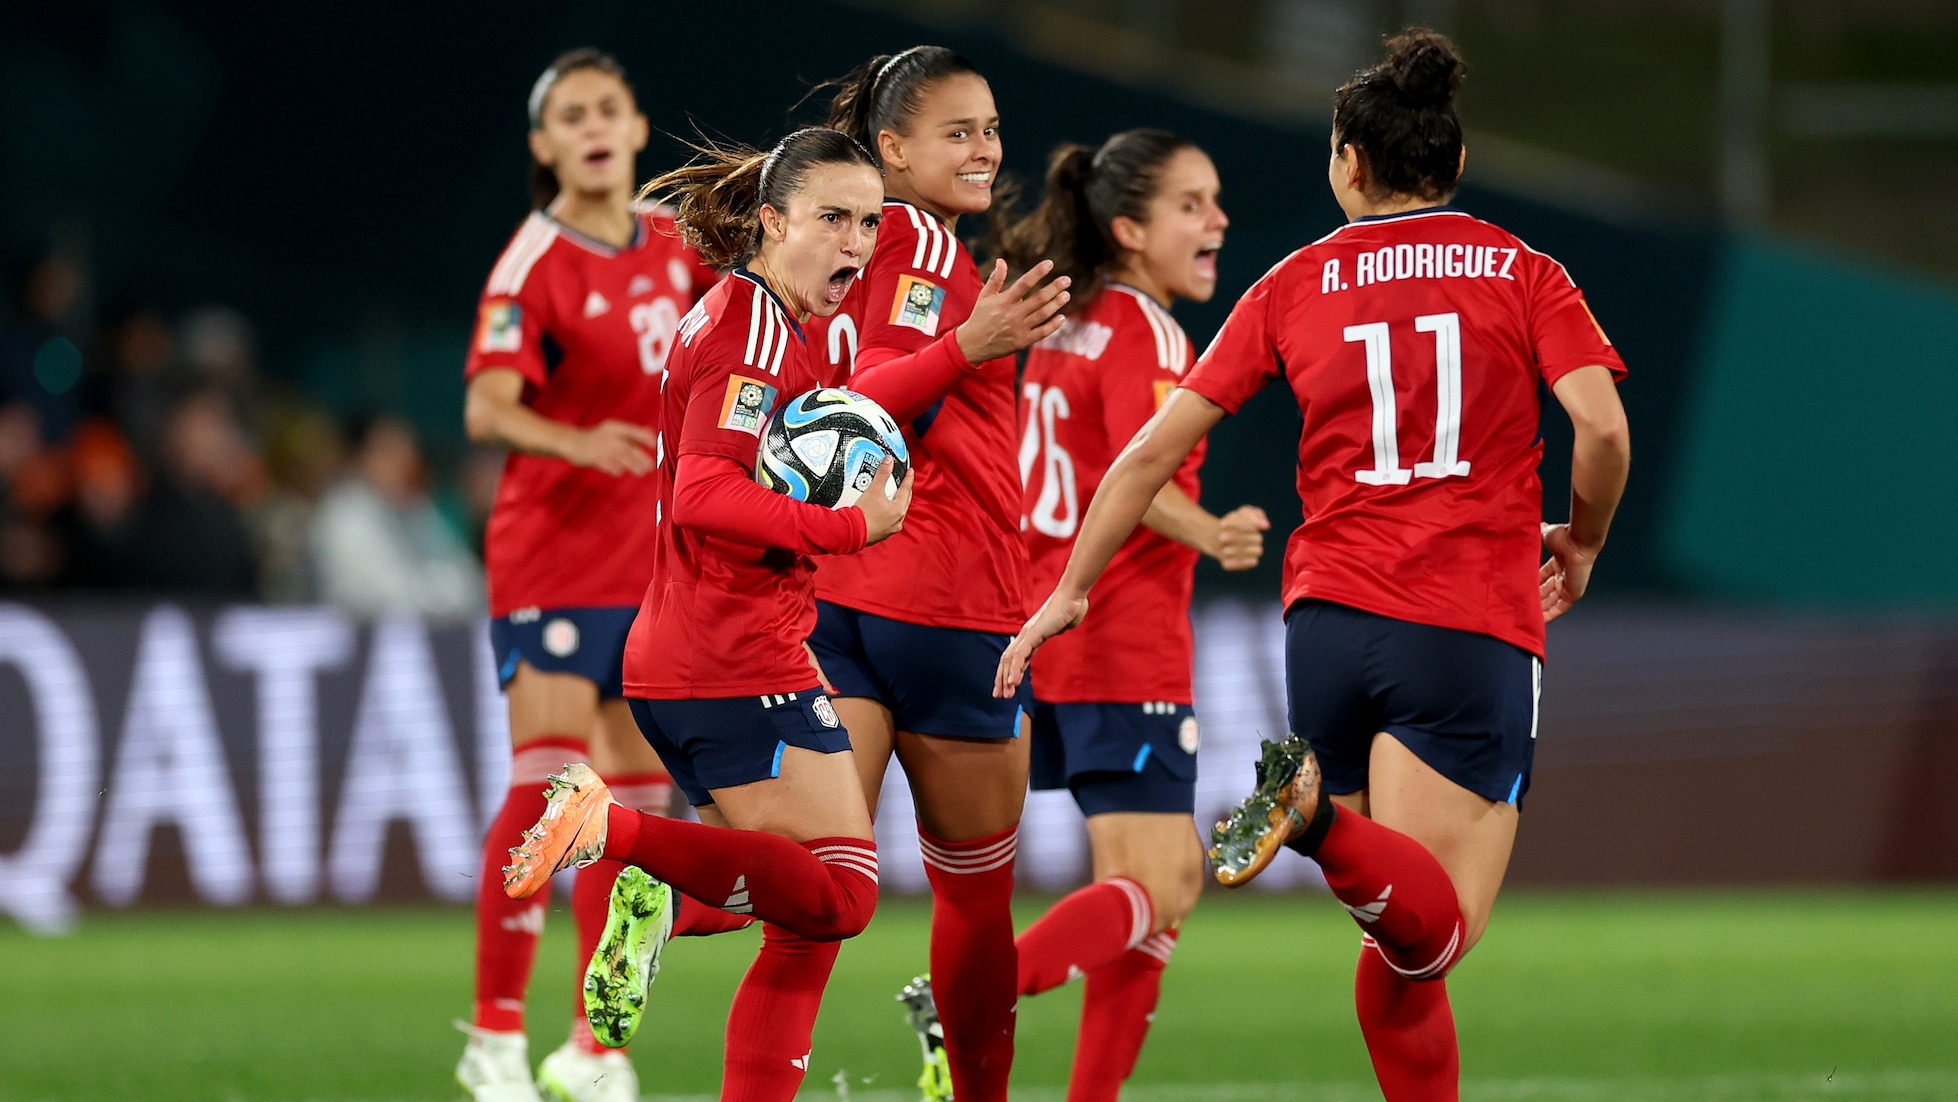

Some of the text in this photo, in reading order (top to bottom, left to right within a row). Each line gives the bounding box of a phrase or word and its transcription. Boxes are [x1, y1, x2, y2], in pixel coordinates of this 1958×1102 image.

[1321, 243, 1519, 294] R. RODRIGUEZ
[1342, 311, 1472, 486] 11
[0, 602, 515, 933] QATA
